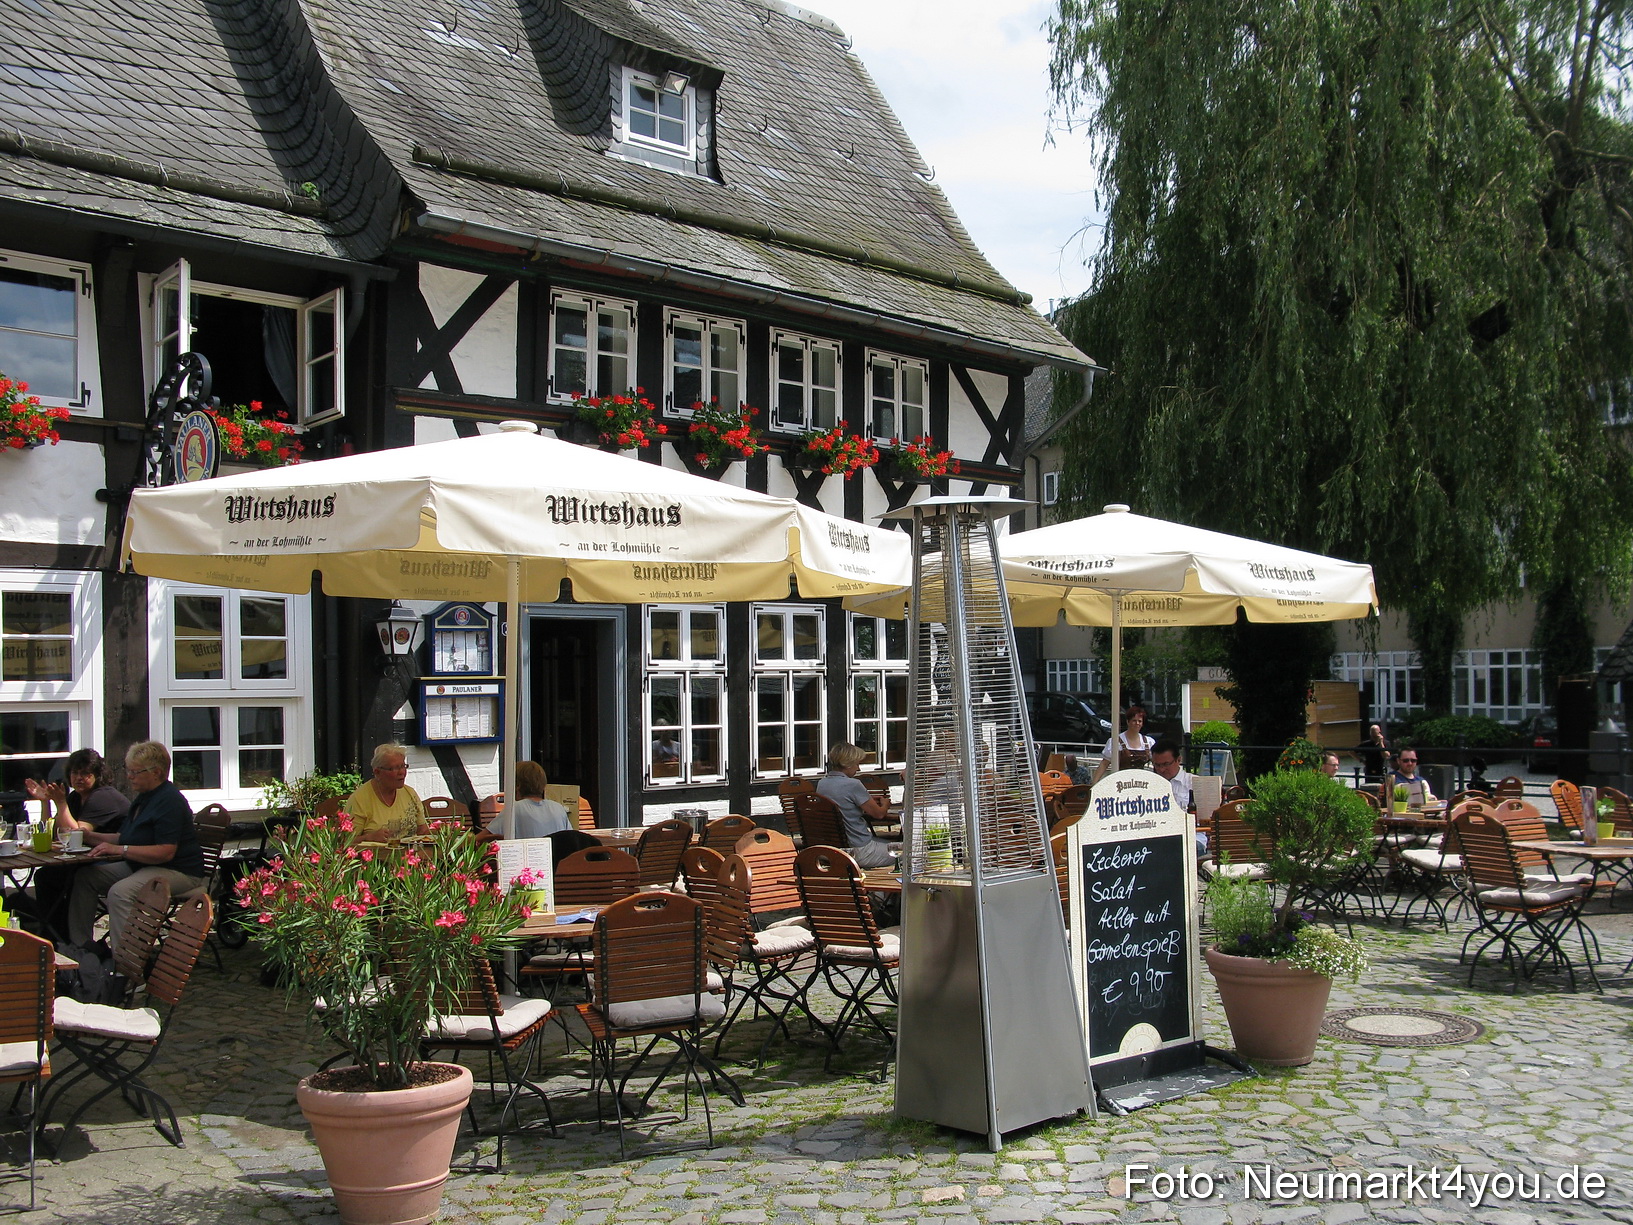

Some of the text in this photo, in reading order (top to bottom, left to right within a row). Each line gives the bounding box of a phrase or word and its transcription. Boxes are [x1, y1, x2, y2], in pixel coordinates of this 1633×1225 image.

[177, 415, 211, 453] PAULANER
[224, 492, 337, 524] Wirtshaus
[545, 494, 682, 529] Wirtshaus
[244, 535, 313, 549] an der Lohmühle
[827, 520, 870, 554] Wirtshaus
[577, 541, 661, 555] an der Lohmühle
[1052, 573, 1063, 581] der
[1065, 573, 1098, 583] Lohmühle
[1247, 562, 1317, 583] Wirtshaus
[452, 685, 483, 694] PAULANER
[1115, 779, 1149, 794] Paulaner
[1094, 793, 1170, 820] Wirtshaus
[1119, 823, 1128, 831] der
[1129, 819, 1157, 831] Lohmühle
[1086, 845, 1152, 872] Leckerer
